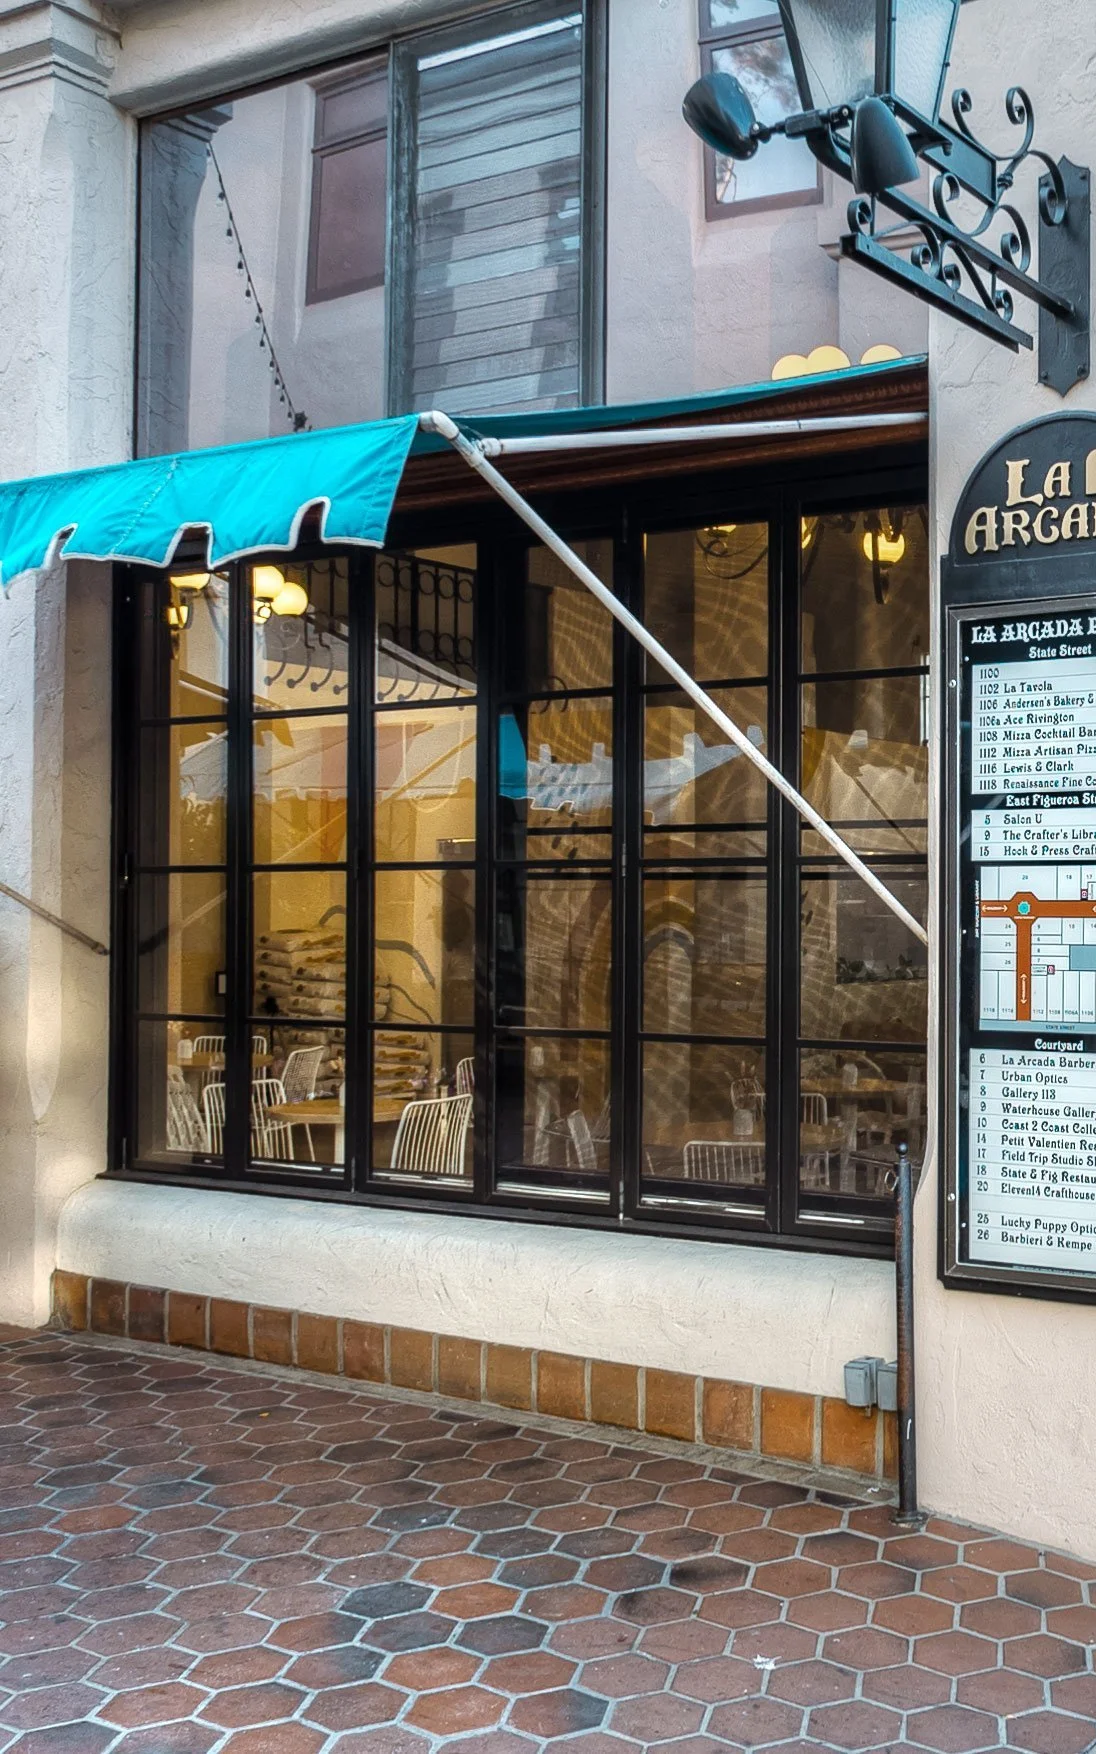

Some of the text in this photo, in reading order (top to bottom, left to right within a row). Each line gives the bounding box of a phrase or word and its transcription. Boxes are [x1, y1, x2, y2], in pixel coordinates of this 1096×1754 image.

[971, 626, 997, 643] LA
[1000, 618, 1083, 642] ARCADA
[1029, 644, 1092, 659] State Street
[980, 668, 999, 679] 1100
[980, 681, 1052, 694] 1102 La Tavola
[980, 699, 998, 710] 1106
[1003, 696, 1051, 709] Andersen's
[1054, 696, 1085, 707] Bakery
[1087, 694, 1094, 704] &
[980, 712, 1074, 726] 1106a Ace Rivington
[980, 731, 998, 742] 1108
[1002, 730, 1031, 741] Mizza
[1034, 727, 1075, 739] Cocktail
[980, 748, 997, 758] 1112
[1002, 747, 1031, 758] Mizza
[1034, 745, 1073, 756] Artisan
[980, 761, 1074, 774] 1116 Lewis & Clark
[980, 780, 997, 790] 1118
[1003, 777, 1059, 789] Renaissance
[1062, 776, 1082, 787] Fine
[1006, 795, 1030, 807] East
[1032, 794, 1079, 808] Figueroa
[984, 813, 1042, 825] 5 Salon U
[984, 830, 990, 840] 9
[1003, 830, 1021, 840] The
[1024, 829, 1068, 840] Crafter's
[980, 847, 989, 857] 15
[1003, 846, 1028, 857] Hook
[1031, 845, 1038, 855] &
[1041, 845, 1069, 855] Press
[1034, 1038, 1083, 1051] Courtyard
[980, 1053, 986, 1064] 6
[1002, 1055, 1014, 1065] La
[1018, 1056, 1055, 1067] Arcada
[1059, 1057, 1095, 1069] Barber
[980, 1070, 1068, 1085] 7 Urban Optics
[980, 1085, 1056, 1100] 8 Gallery 113
[980, 1101, 986, 1112] 9
[1002, 1102, 1060, 1117] Waterhouse
[977, 1118, 987, 1128] 10
[1002, 1119, 1029, 1131] Coast
[1032, 1121, 1038, 1131] 2
[1041, 1121, 1069, 1133] Coast
[977, 1133, 986, 1144] 14
[1001, 1135, 1024, 1147] Petit
[1028, 1137, 1076, 1150] Valentien
[977, 1149, 986, 1159] 17
[1002, 1150, 1025, 1162] Field
[1029, 1152, 1048, 1164] Trip
[1051, 1153, 1083, 1166] Studio
[977, 1165, 987, 1175] 18
[1001, 1167, 1027, 1179] State
[1030, 1169, 1037, 1179] &
[1041, 1169, 1058, 1184] Fig
[977, 1181, 989, 1191] 20
[1001, 1183, 1041, 1196] Eleven14
[1044, 1186, 1095, 1200] Crafthouse
[977, 1214, 989, 1224] 25
[1001, 1216, 1030, 1229] Lucky
[1034, 1219, 1067, 1233] Puppy
[977, 1229, 989, 1240] 26
[1001, 1232, 1042, 1246] Barbieri
[1047, 1235, 1053, 1246] &
[1058, 1237, 1092, 1251] Kempe
